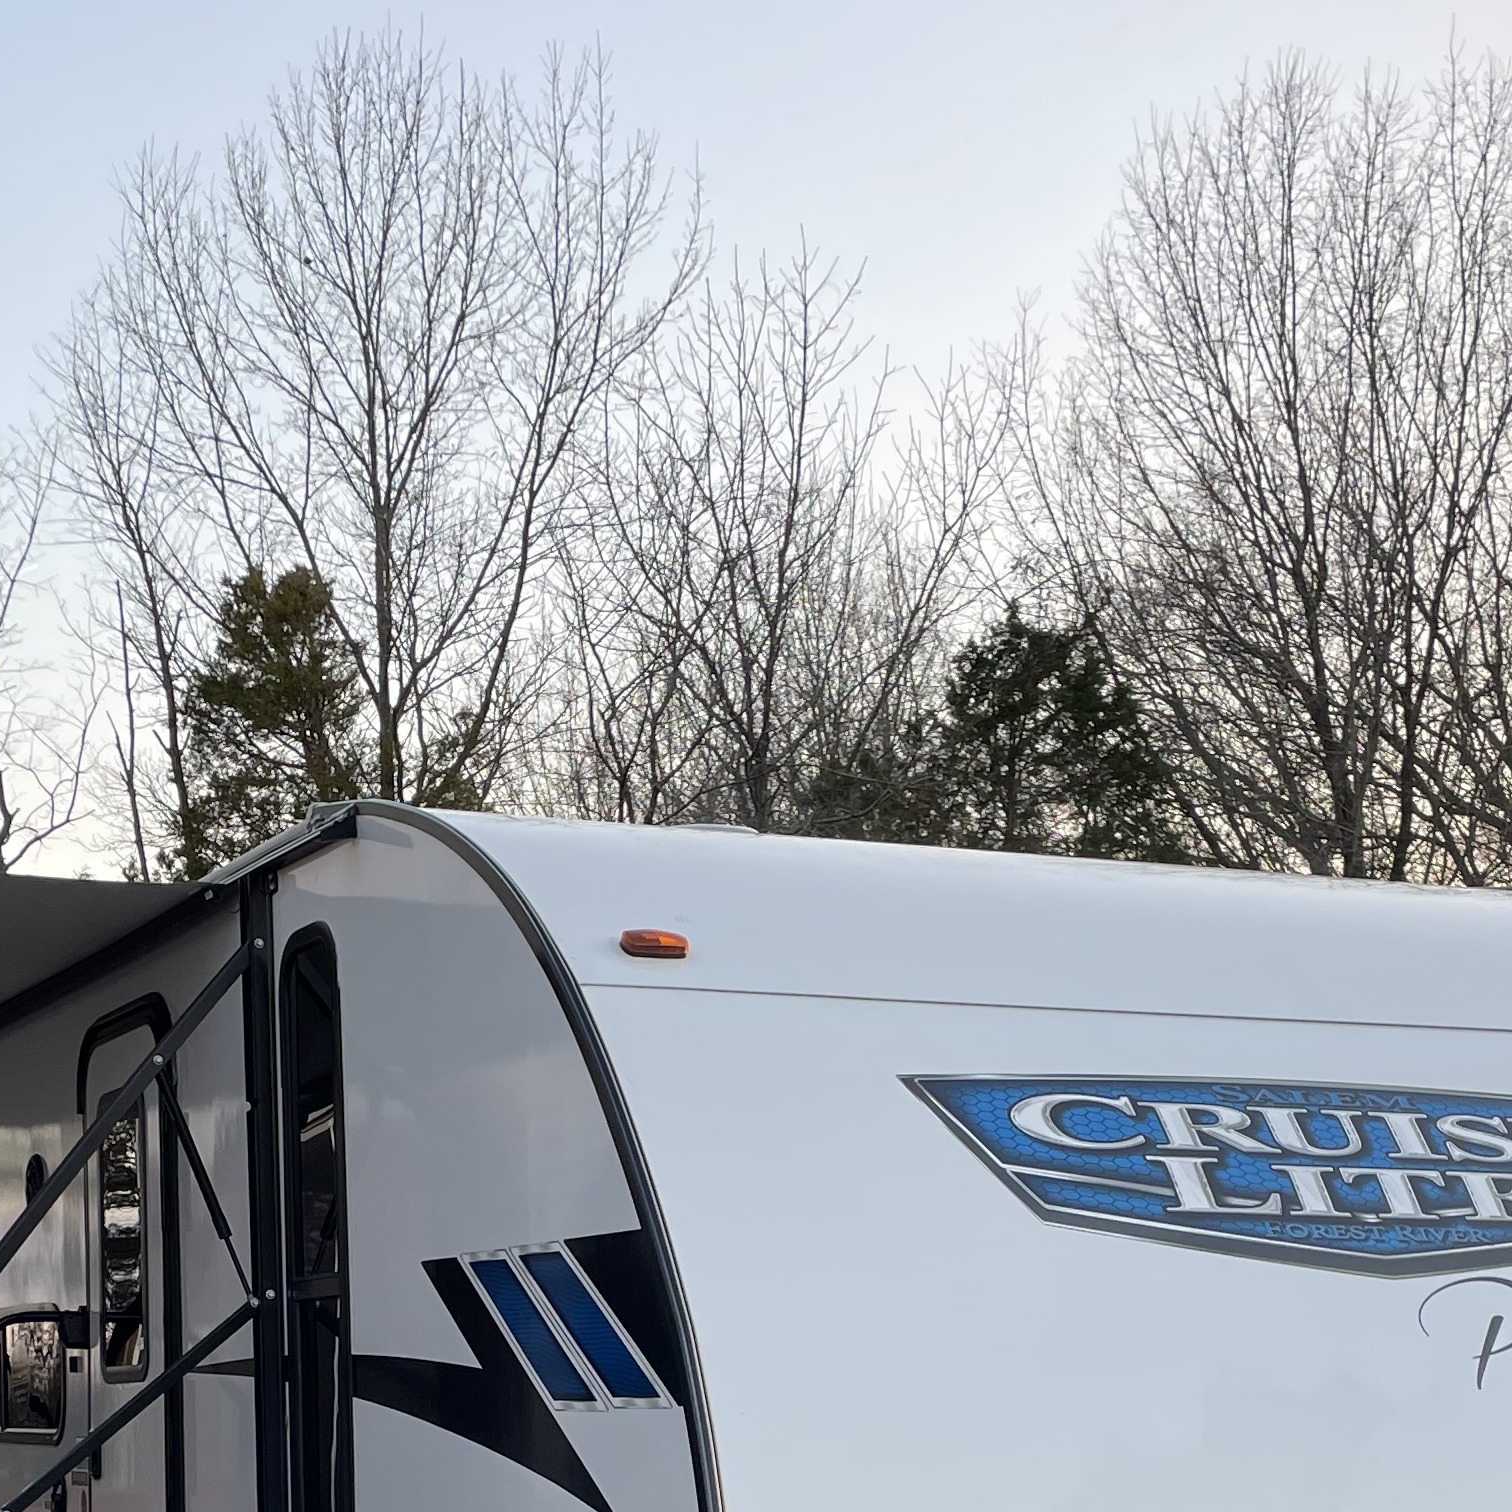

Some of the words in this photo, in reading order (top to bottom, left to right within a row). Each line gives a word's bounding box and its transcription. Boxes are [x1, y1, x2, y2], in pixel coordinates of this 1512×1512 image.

[1211, 1084, 1418, 1110] SALEM
[1261, 1221, 1385, 1242] FOREST
[1393, 1225, 1489, 1243] RIVER
